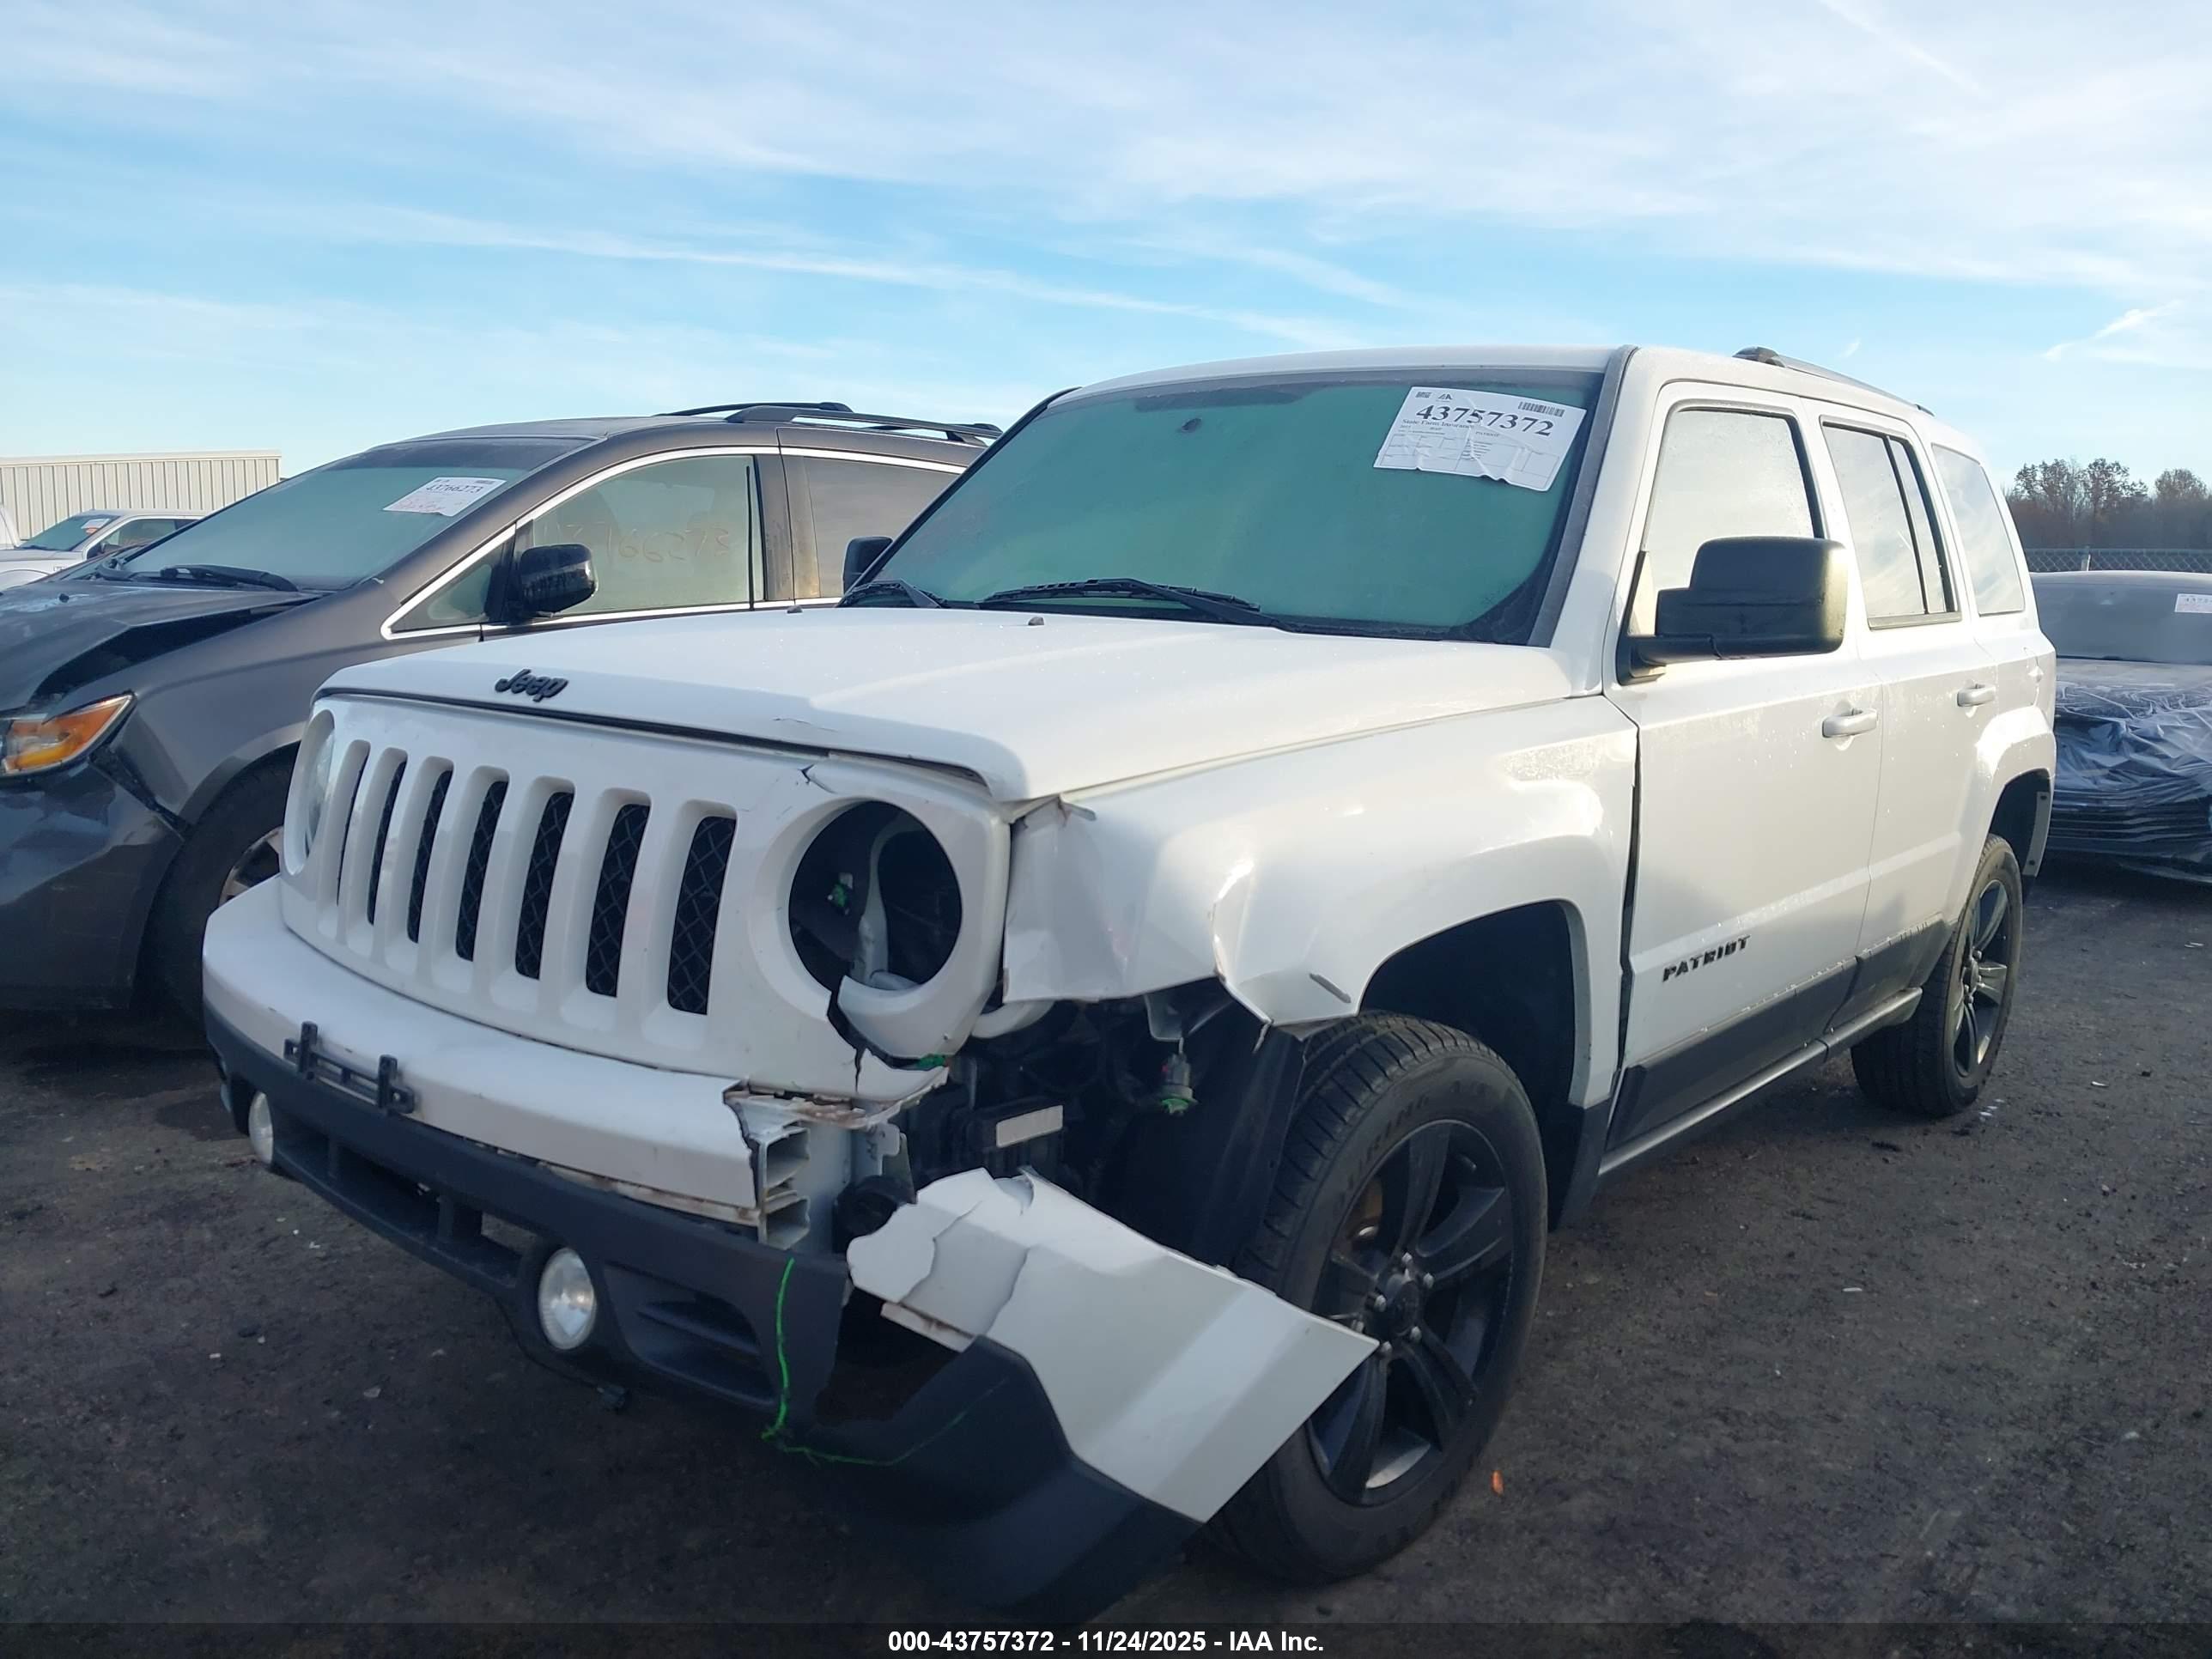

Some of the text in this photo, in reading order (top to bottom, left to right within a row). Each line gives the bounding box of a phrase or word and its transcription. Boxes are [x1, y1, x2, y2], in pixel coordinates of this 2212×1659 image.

[1415, 404, 1554, 436] 43757372
[495, 668, 568, 702] Jeep
[1662, 935, 1751, 981] PATRIOT
